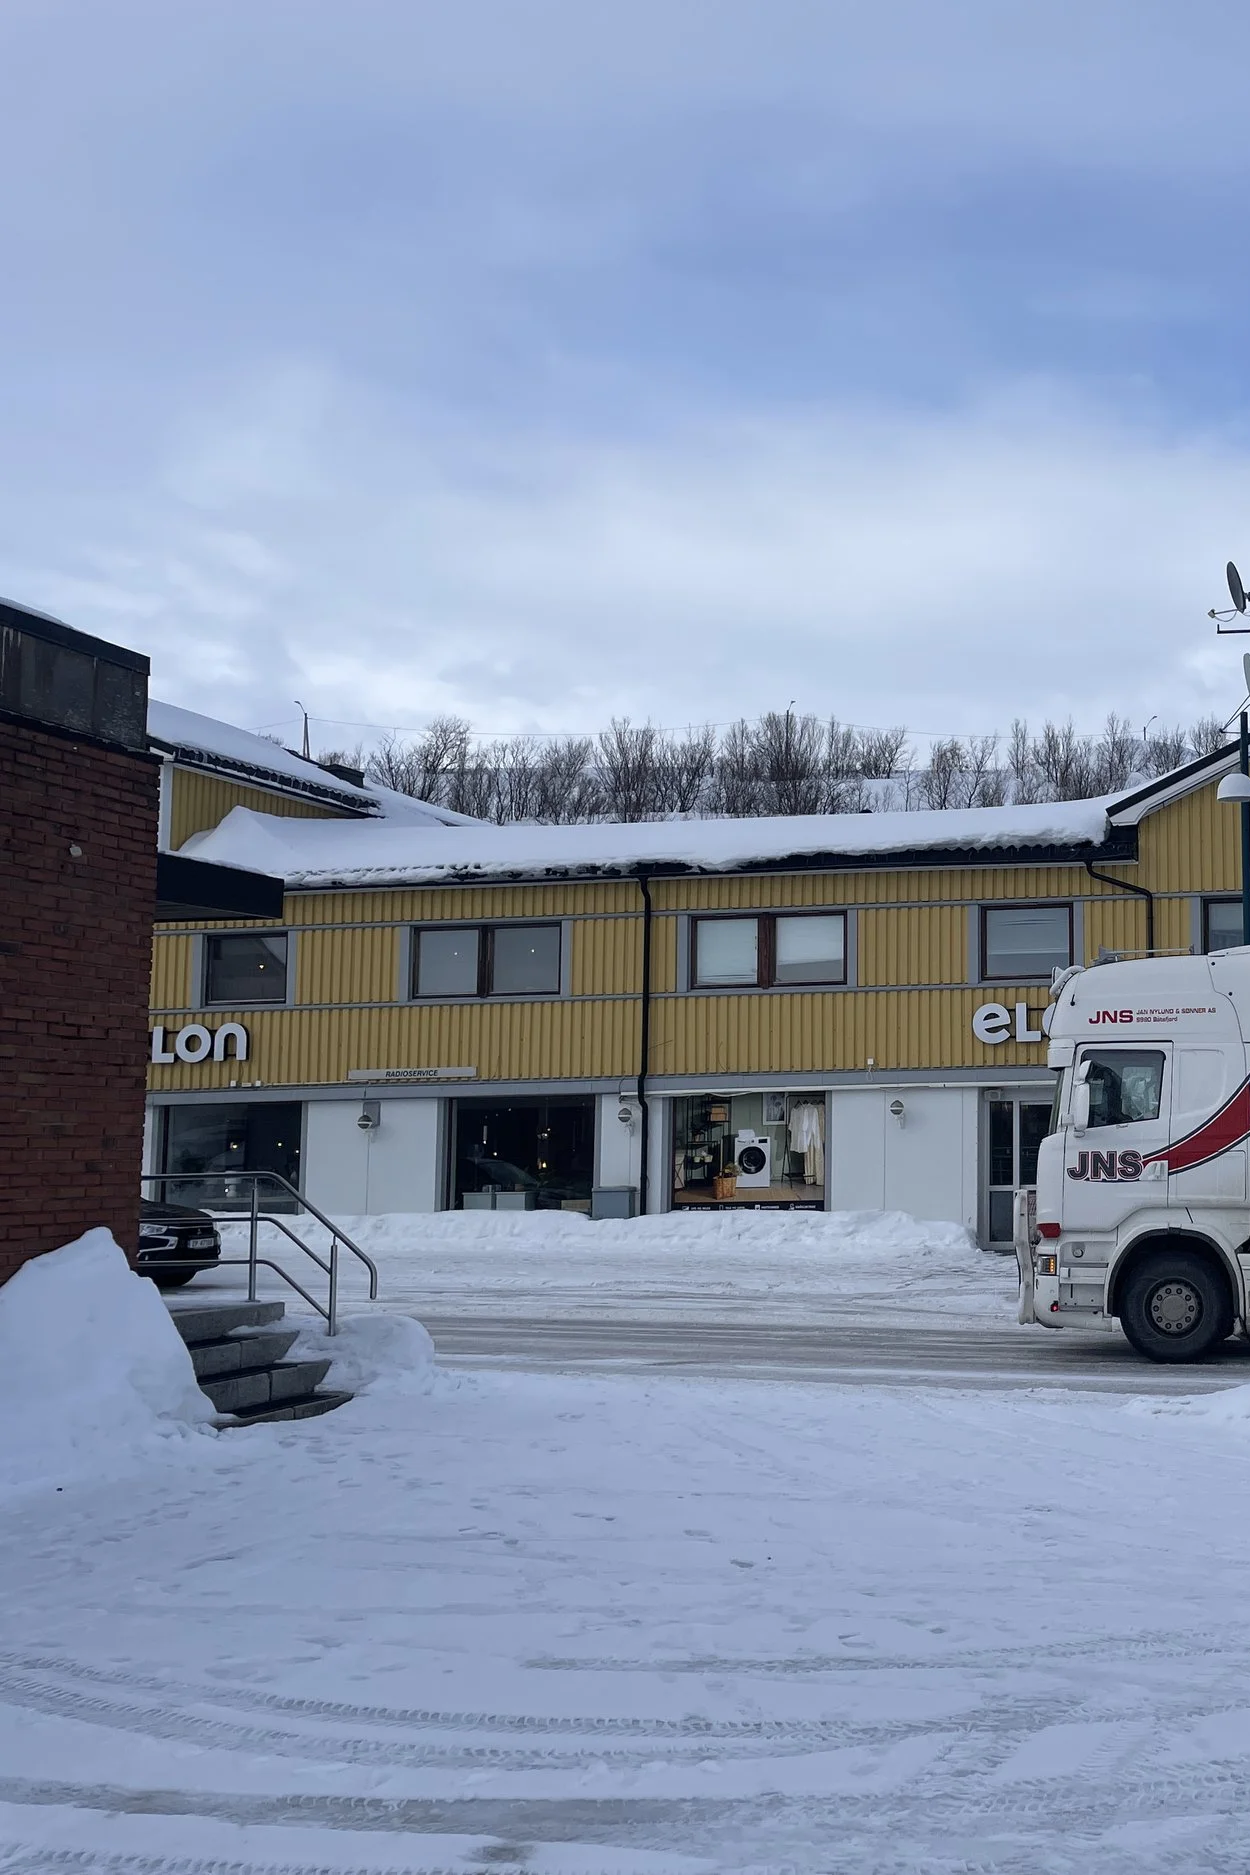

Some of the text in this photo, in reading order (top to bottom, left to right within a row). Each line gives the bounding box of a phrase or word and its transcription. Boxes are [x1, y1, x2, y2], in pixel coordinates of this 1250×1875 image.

[1088, 1009, 1134, 1024] JNS
[385, 1069, 438, 1077] RADIOSERVICE
[1066, 1149, 1143, 1181] JNS
